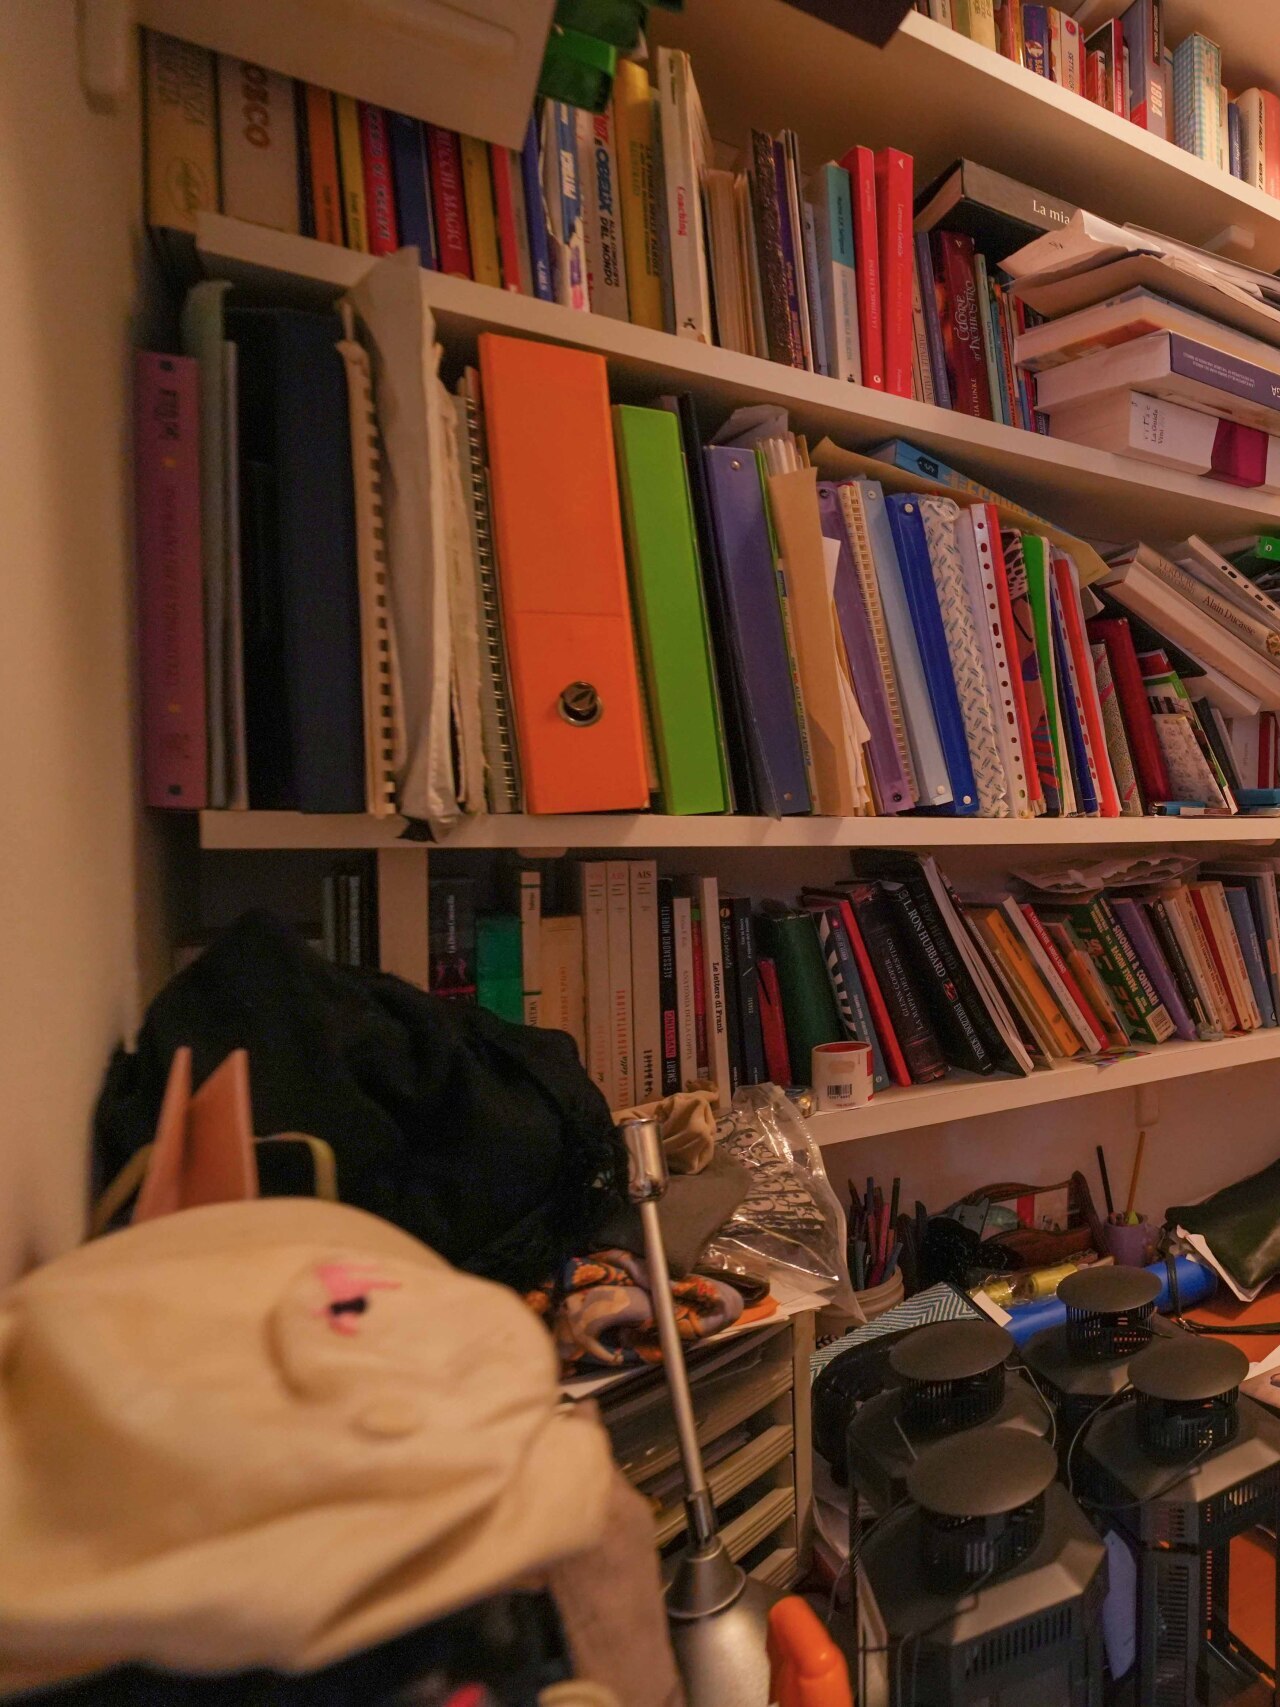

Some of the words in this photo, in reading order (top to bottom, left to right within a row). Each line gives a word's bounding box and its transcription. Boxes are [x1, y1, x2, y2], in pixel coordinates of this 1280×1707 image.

[1150, 81, 1162, 118] 1984
[596, 148, 613, 216] OBELIX
[675, 186, 690, 237] Coaching
[1033, 199, 1046, 216] La
[1049, 208, 1071, 225] mia
[599, 216, 609, 240] DEL
[602, 242, 613, 286] MONDO
[970, 378, 978, 398] FUNKE
[1151, 409, 1159, 432] Guida
[1151, 432, 1157, 443] La
[1203, 594, 1225, 616] Alain
[1223, 611, 1257, 636] Ducasse
[637, 870, 652, 879] AIS
[661, 906, 671, 934] MORETTI
[903, 899, 913, 910] L.
[908, 908, 924, 932] RON
[917, 930, 947, 978] HUBBARD
[663, 936, 673, 979] ALESSANDRO
[712, 961, 720, 972] Le
[886, 937, 906, 976] DESTINO
[1112, 924, 1137, 962] SINONIMI
[1131, 960, 1140, 971] &
[1136, 968, 1160, 1006] CONTRARI
[683, 969, 691, 1008] ANATOMIA
[713, 973, 721, 999] lettere
[884, 958, 901, 991] COOPER
[901, 974, 910, 992] DEL
[715, 1000, 723, 1008] di
[894, 990, 910, 1018] GLENN
[905, 991, 919, 1019] MAPPA
[616, 990, 628, 1056] DEGUSTAZIONE
[664, 1010, 677, 1058] INVESTING
[684, 1008, 692, 1034] DELLA
[715, 1009, 724, 1034] Frank
[914, 1019, 925, 1031] LA
[970, 1037, 986, 1061] SCIENZA
[619, 1056, 629, 1076] della
[666, 1060, 677, 1083] SMART
[618, 1077, 629, 1108] ECNICA
